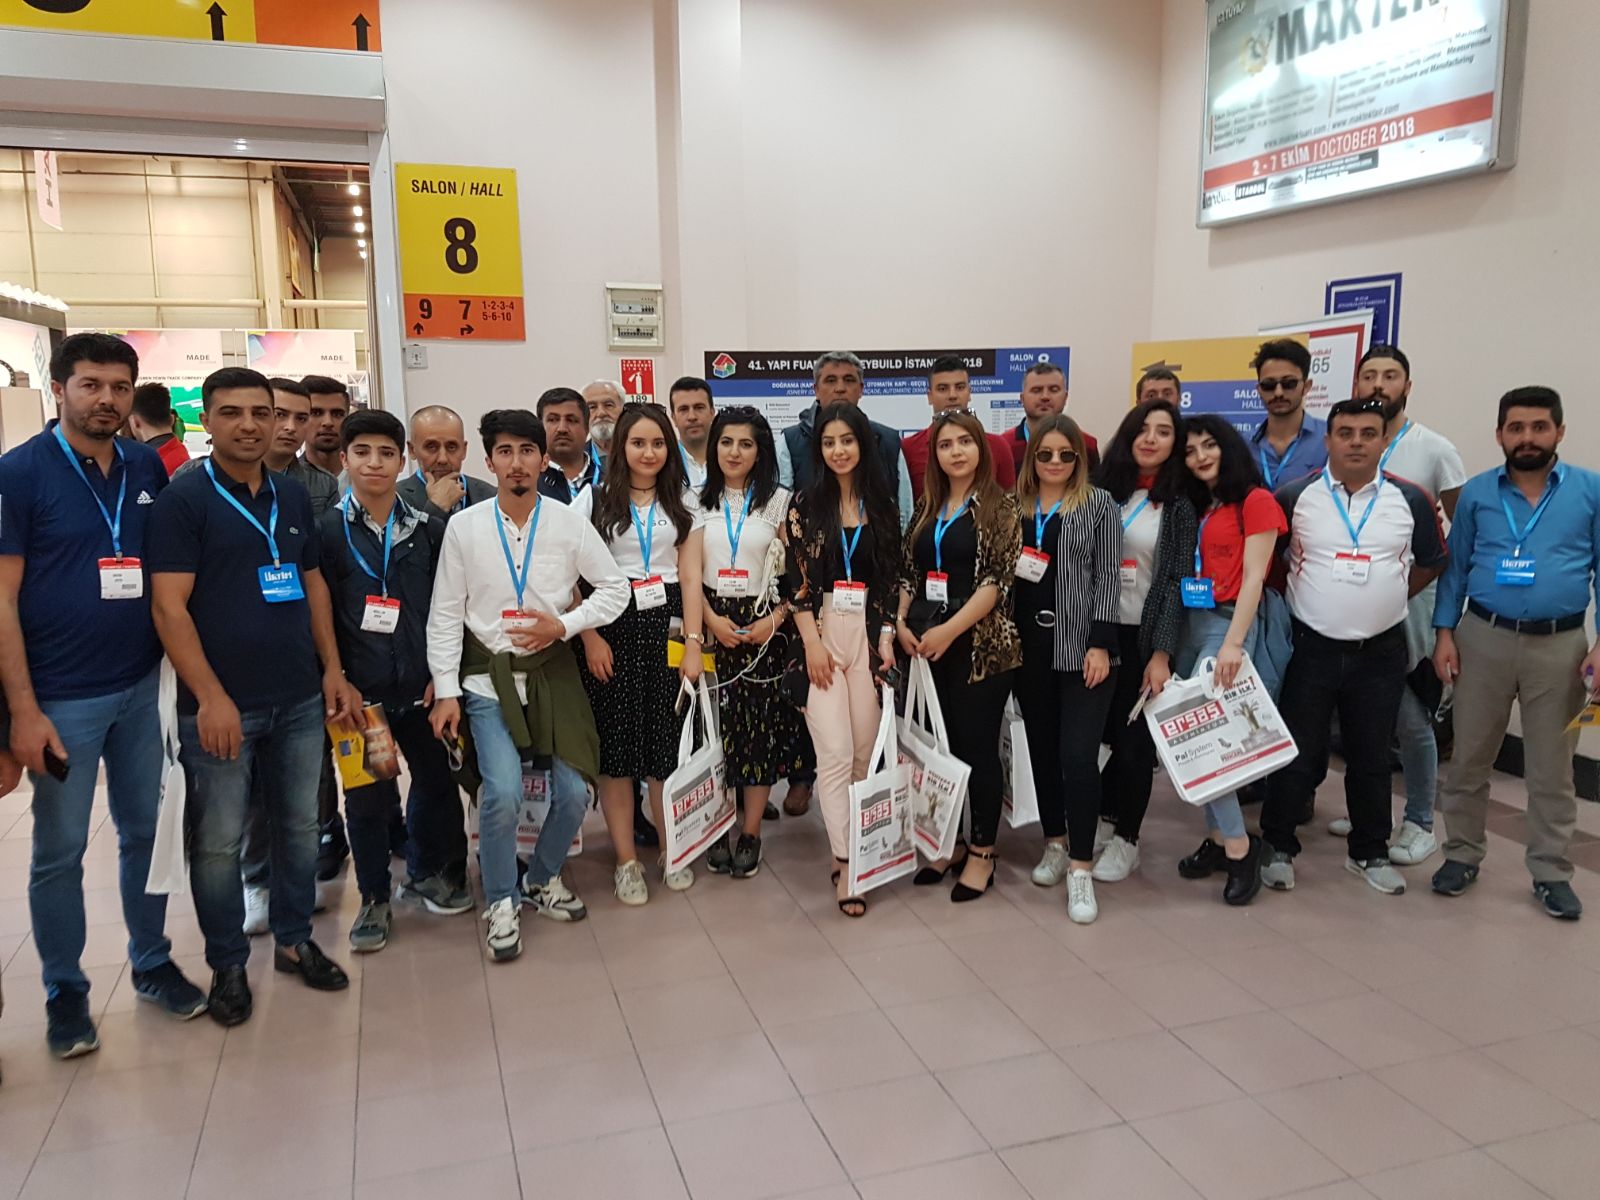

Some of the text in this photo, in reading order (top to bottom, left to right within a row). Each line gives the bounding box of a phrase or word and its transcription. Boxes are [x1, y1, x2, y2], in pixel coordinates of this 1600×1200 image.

[1252, 160, 1260, 176] 2
[1270, 156, 1277, 171] 7
[1281, 145, 1310, 169] EKİM
[1380, 118, 1415, 143] 2018
[411, 179, 457, 195] SALON
[469, 182, 504, 197] HALL
[443, 217, 479, 274] 8
[419, 298, 433, 320] 9
[458, 300, 472, 320] 7
[482, 301, 514, 311] 1-2-3-4
[482, 311, 512, 321] 5-6-10
[748, 360, 765, 371] 41.
[767, 360, 790, 370] YAPI
[859, 359, 902, 369] EYBUILD
[905, 357, 937, 369] İSTAN
[1010, 353, 1034, 362] SALON
[1010, 364, 1027, 372] HALL
[1312, 356, 1330, 374] 65
[1180, 391, 1192, 408] 8
[1234, 389, 1260, 399] SALO
[1241, 400, 1264, 409] HALL
[1175, 751, 1188, 762] Pal
